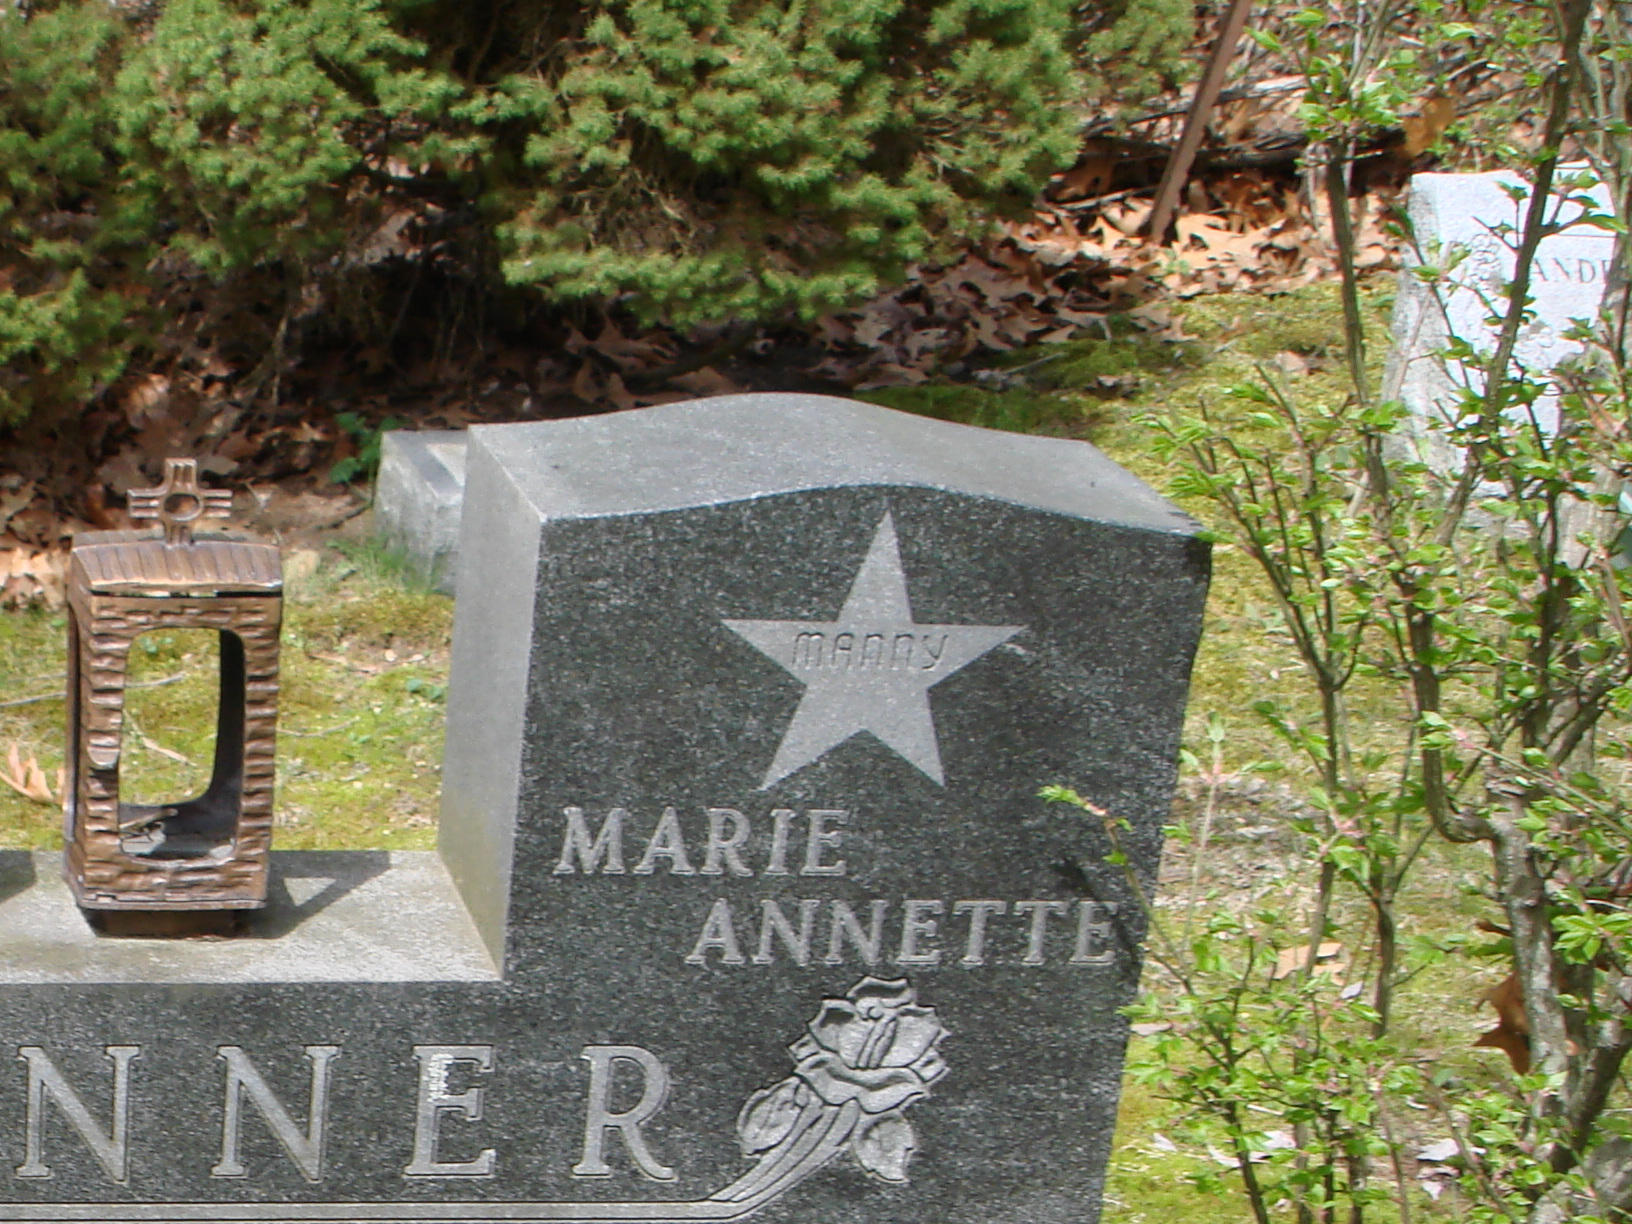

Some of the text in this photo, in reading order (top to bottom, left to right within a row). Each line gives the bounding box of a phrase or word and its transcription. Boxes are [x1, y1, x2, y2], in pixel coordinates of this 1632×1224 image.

[791, 629, 950, 672] MANNY
[553, 806, 850, 877] MARIE
[685, 898, 1120, 967] ANNETTE
